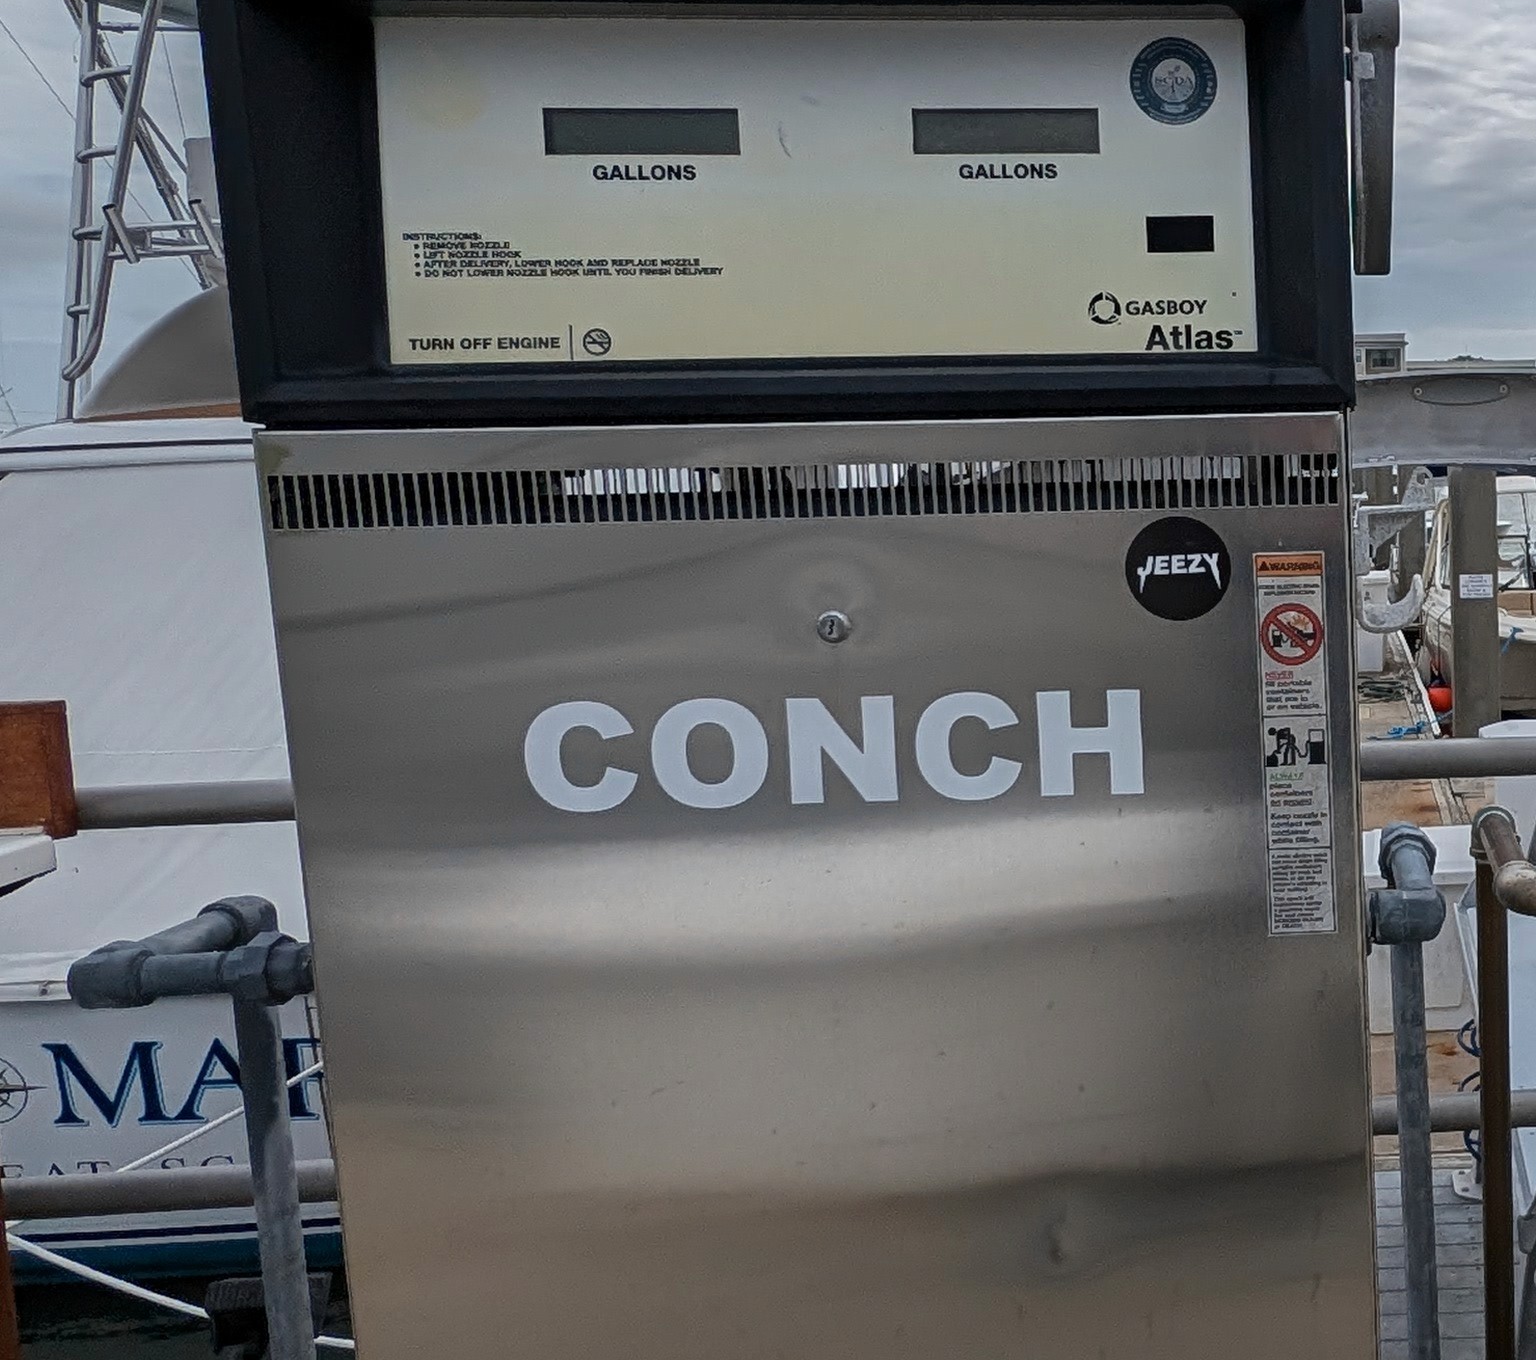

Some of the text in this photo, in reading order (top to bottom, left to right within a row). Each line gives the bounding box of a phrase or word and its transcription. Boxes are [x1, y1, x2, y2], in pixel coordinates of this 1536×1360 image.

[592, 164, 696, 181] GALLONS
[958, 162, 1058, 180] GALLONS
[423, 241, 510, 250] REMOVE NOZZLE
[423, 251, 445, 259] LIFT
[423, 260, 457, 268] AFTER
[515, 260, 551, 268] LOWER
[554, 259, 583, 267] HOOK
[587, 259, 608, 267] AND
[611, 259, 658, 267] REPLACE
[660, 258, 700, 267] NOZZLE
[442, 269, 463, 277] NOT
[467, 269, 504, 277] LOWER
[506, 269, 547, 277] NOZZLE
[582, 268, 612, 276] UNTIL
[615, 268, 636, 276] YOU
[639, 268, 671, 276] FINISH
[674, 267, 724, 275] DELIVERY
[1125, 299, 1208, 315] GASBOY
[408, 337, 561, 350] TURN OFF ENGINE
[1137, 552, 1222, 594] JEEZY
[523, 688, 1144, 812] CONCH
